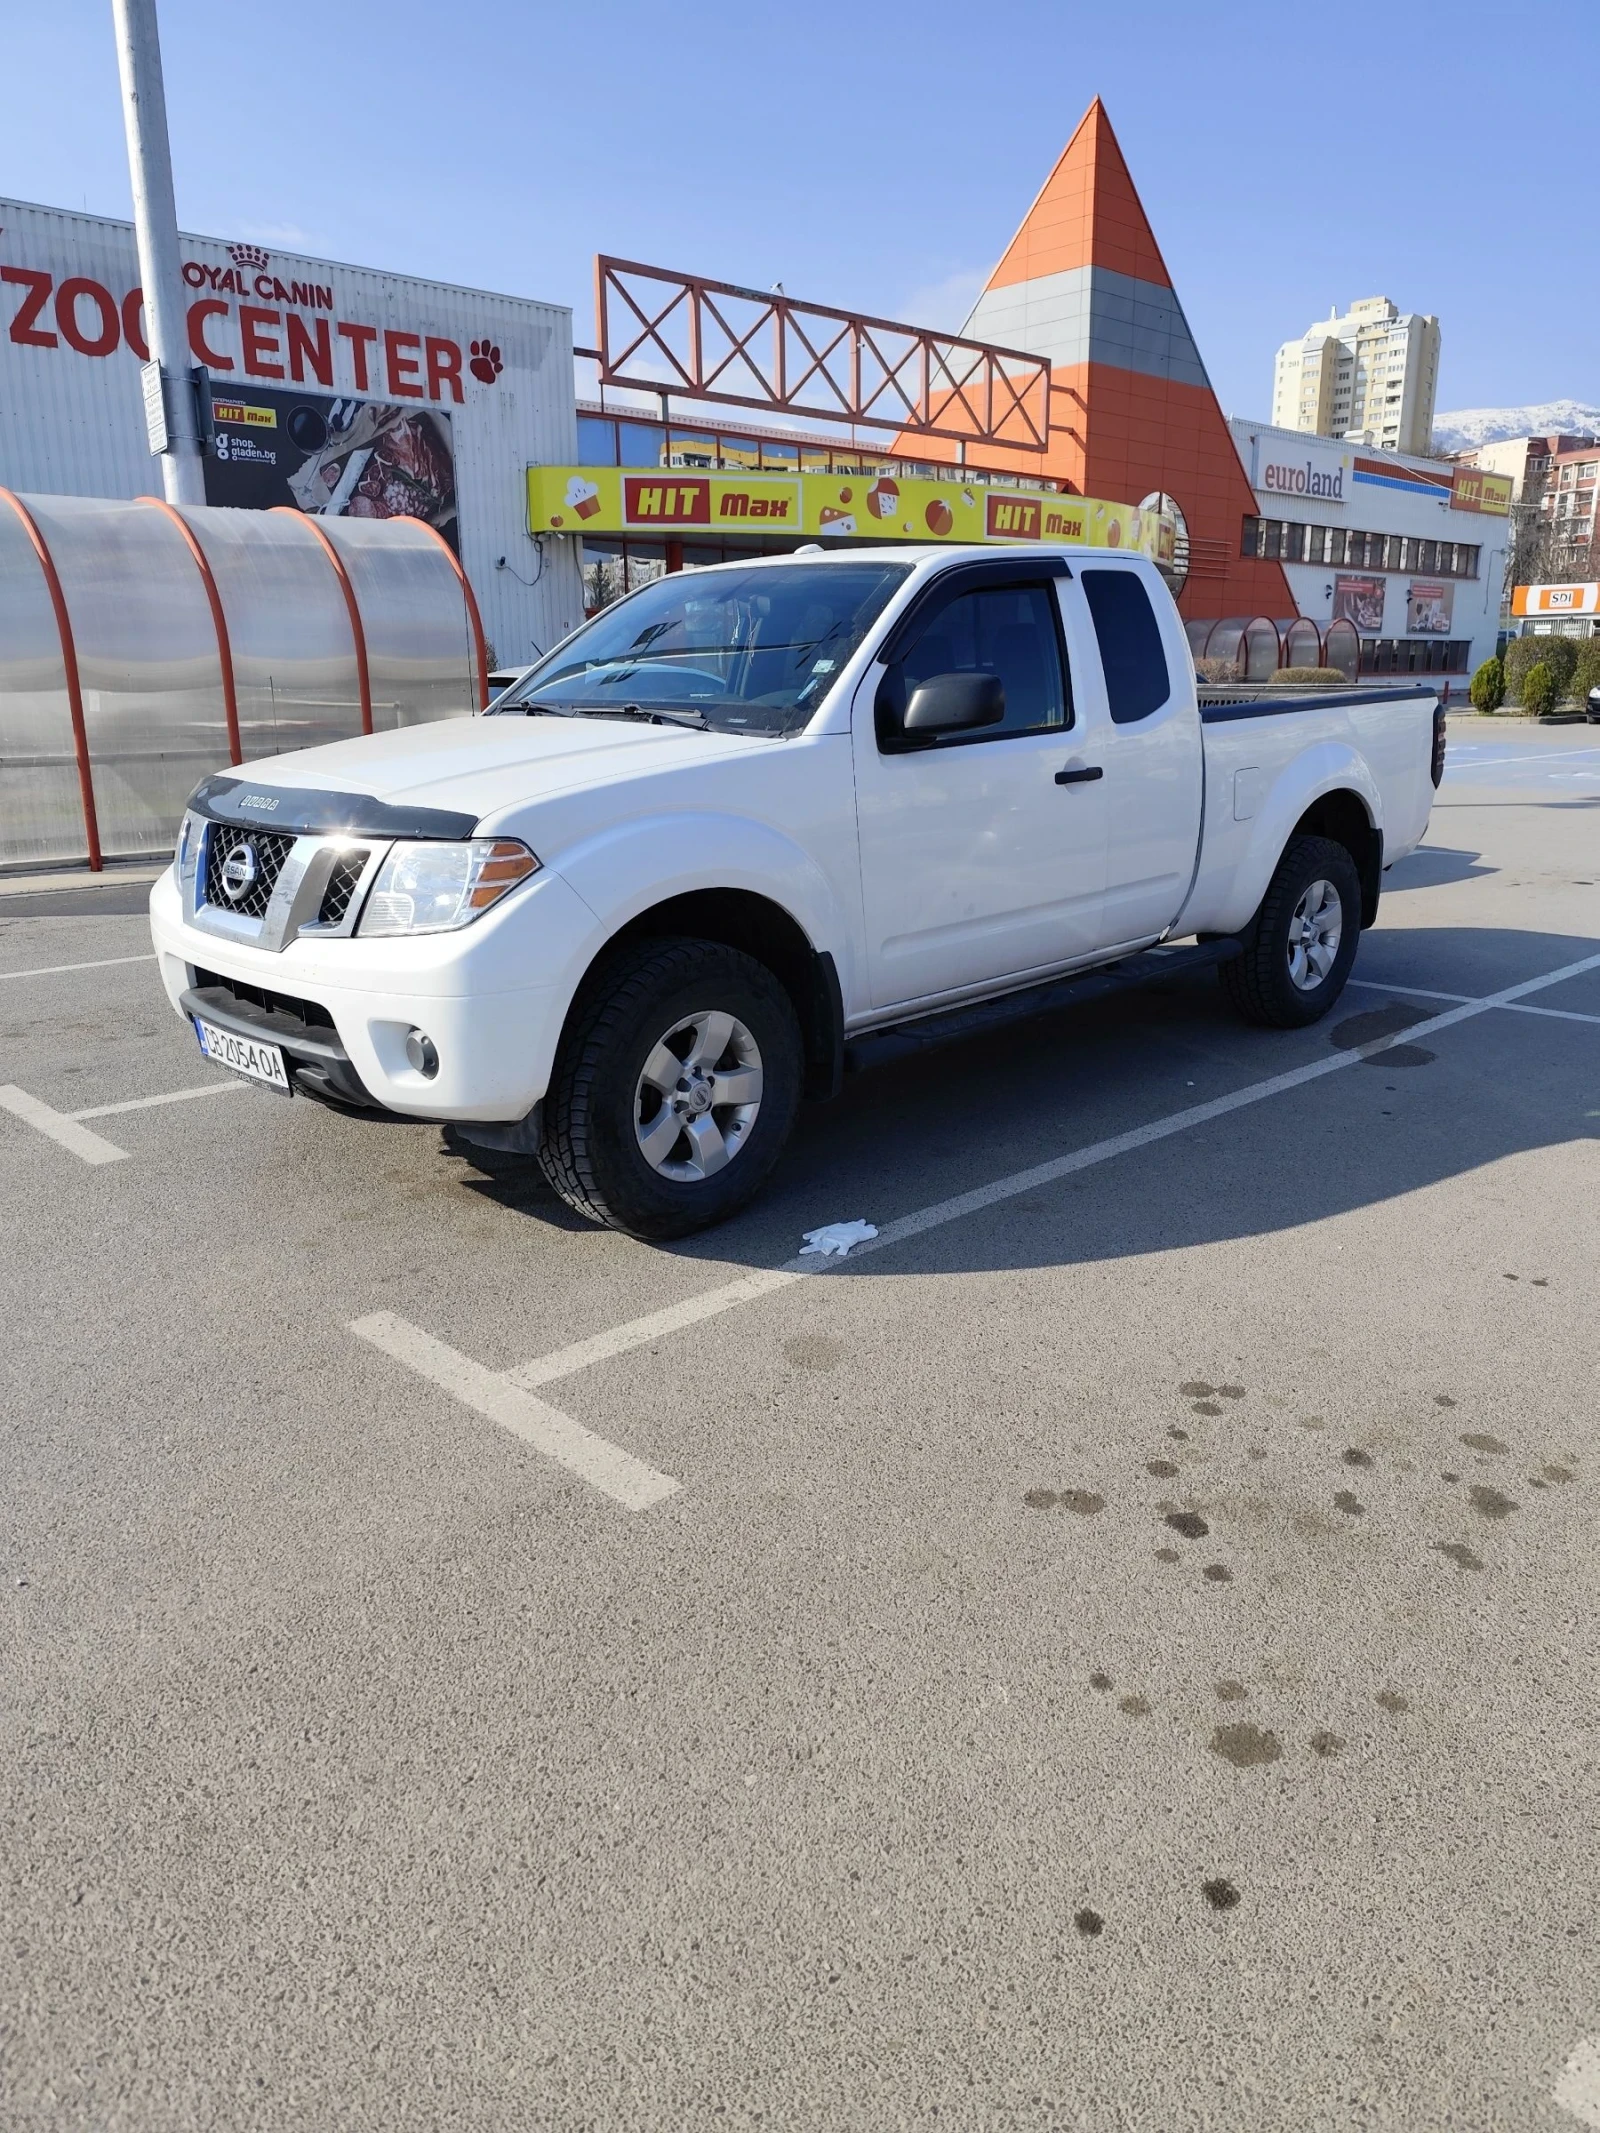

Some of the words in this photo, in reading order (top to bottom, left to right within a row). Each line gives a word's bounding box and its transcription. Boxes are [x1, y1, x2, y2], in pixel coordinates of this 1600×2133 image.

[181, 261, 250, 296] OYAL
[255, 275, 333, 310] CANIN
[219, 407, 241, 419] HIT
[1265, 461, 1343, 498] euroland
[1456, 479, 1479, 502] HIT
[637, 487, 700, 516] HIT
[995, 504, 1036, 532] HIT
[1551, 593, 1572, 604] SDI
